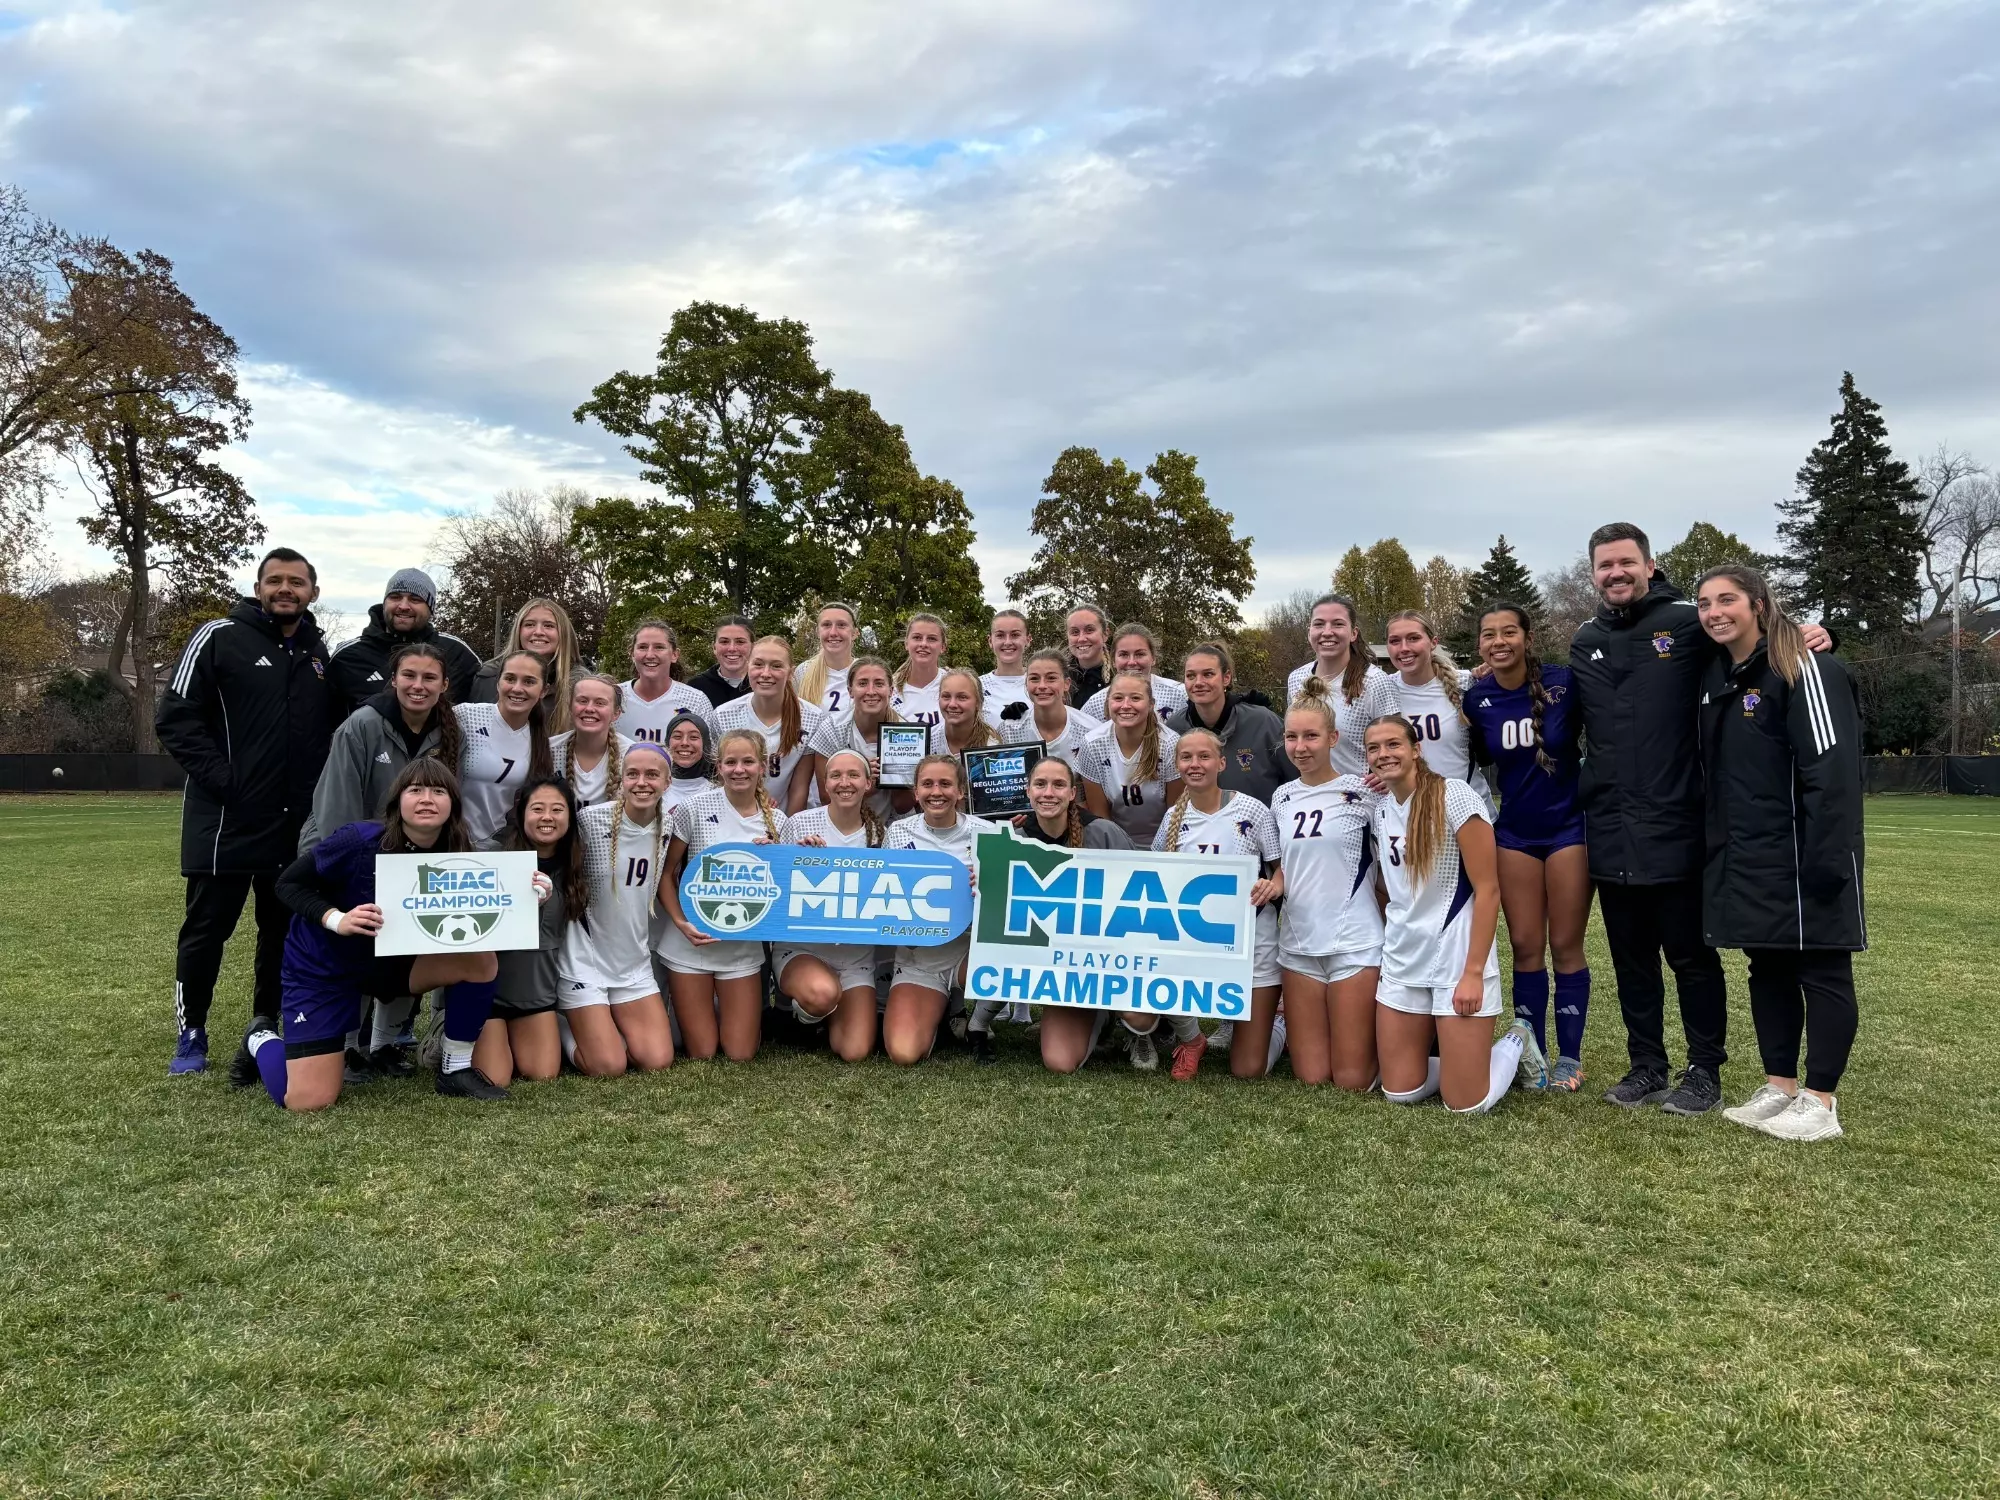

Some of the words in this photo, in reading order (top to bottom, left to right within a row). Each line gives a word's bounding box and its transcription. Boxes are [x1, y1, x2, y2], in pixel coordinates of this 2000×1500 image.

[828, 690, 840, 712] 2
[1408, 713, 1441, 741] 30
[1502, 717, 1535, 750] 00
[892, 734, 917, 743] MIAC
[494, 757, 515, 784] 7
[989, 759, 1023, 774] MIAC
[973, 779, 1007, 788] REGULAR
[1009, 776, 1028, 785] SEAS
[1121, 783, 1144, 807] 18
[1293, 809, 1323, 839] 22
[1389, 835, 1407, 867] 3
[625, 856, 649, 887] 19
[709, 863, 766, 882] MIAC
[793, 856, 830, 868] 2024
[833, 858, 885, 869] SOCCER
[428, 870, 495, 892] MIAC
[687, 884, 779, 898] CHAMPIONS
[402, 894, 513, 910] CHAMPIONS
[788, 869, 952, 922] MIAC
[1008, 864, 1238, 945] MIAC
[881, 925, 950, 937] PLAYOFFS
[1052, 950, 1160, 972] PLAYOFF
[971, 965, 1245, 1016] CHAMPIONS
